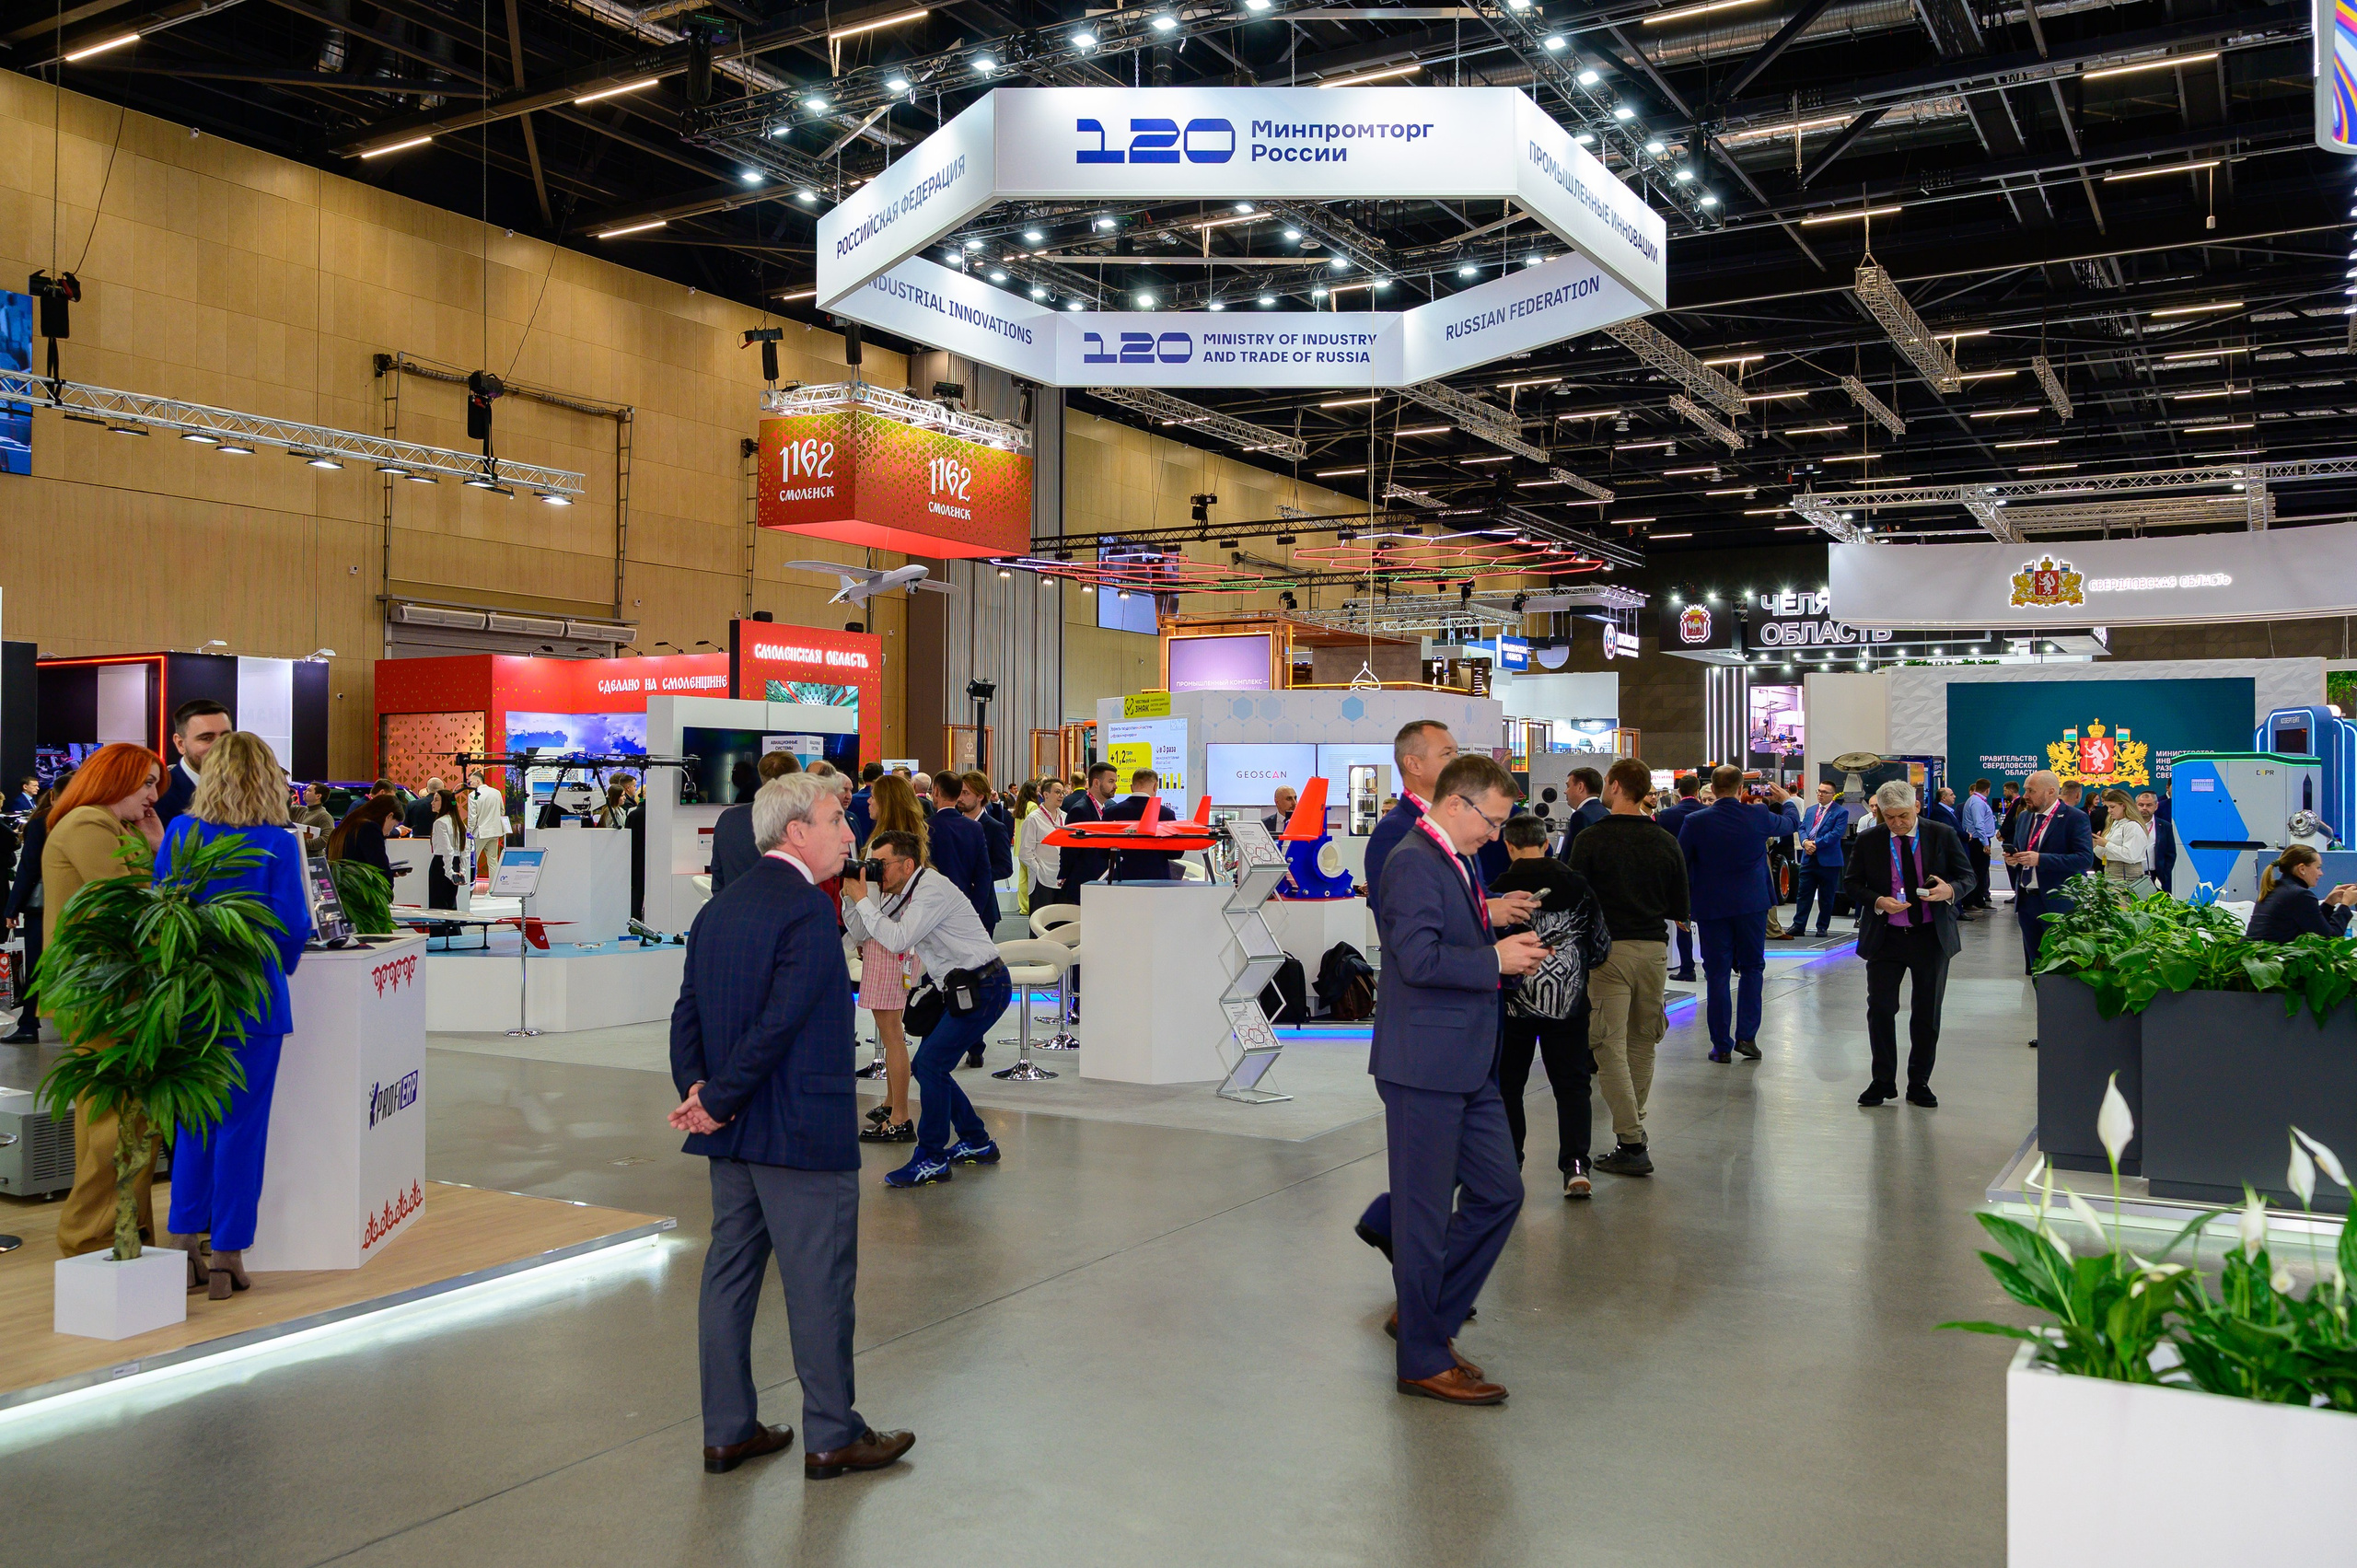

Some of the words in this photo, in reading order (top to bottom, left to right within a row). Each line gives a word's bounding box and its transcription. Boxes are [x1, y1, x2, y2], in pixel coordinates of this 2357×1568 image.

[1076, 118, 1236, 164] 120
[1251, 121, 1434, 142] Минпромторг
[1251, 144, 1347, 162] России
[837, 200, 899, 260] РОССИЙСКАЯ
[900, 154, 966, 215] ФЕДЕРАЦИЯ
[1529, 140, 1610, 225] ПРОМЫШЛЕННЫЕ
[1611, 210, 1658, 264] ИННОВАЦИИ
[867, 274, 946, 314] NDUSTRIAL
[948, 300, 1032, 345] INNOVATIONS
[1446, 307, 1505, 341] RUSSIAN
[1509, 274, 1600, 320] FEDERATION
[1084, 332, 1192, 364] 120
[1203, 333, 1275, 345] MINISTRY
[1279, 333, 1298, 345] OF
[1303, 333, 1377, 345] INDUSTRY
[1203, 351, 1236, 363] AND
[1241, 351, 1289, 363] TRADE
[1293, 351, 1312, 363] OF
[1317, 351, 1371, 363] RUSSIA
[780, 438, 835, 483] 1162
[929, 456, 971, 502] 1162
[779, 485, 835, 502] СМОЛЕНСК
[928, 501, 971, 521] СМОЛЕНСК
[2089, 576, 2177, 592] СВЕРДЛОВСКАЯ
[2179, 573, 2233, 588] ОБЛАСТЬ
[1760, 592, 1830, 616] ЧЕЛЯ
[1760, 621, 1892, 645] ОБЛАСТЬ
[755, 643, 822, 664] СМОЛЕНСКАЯ
[826, 651, 869, 668] ОБЛАСТЬ
[598, 678, 640, 694] СДЕЛАНО
[644, 678, 657, 691] НА
[662, 674, 727, 691] СМОЛЕНЩИНЕ
[1176, 679, 1229, 687] ПРОМЫШЛЕННЫЙ
[1237, 771, 1287, 779] GEOSCAN
[1982, 761, 2038, 770] СВЕРДЛОВСКОЙ
